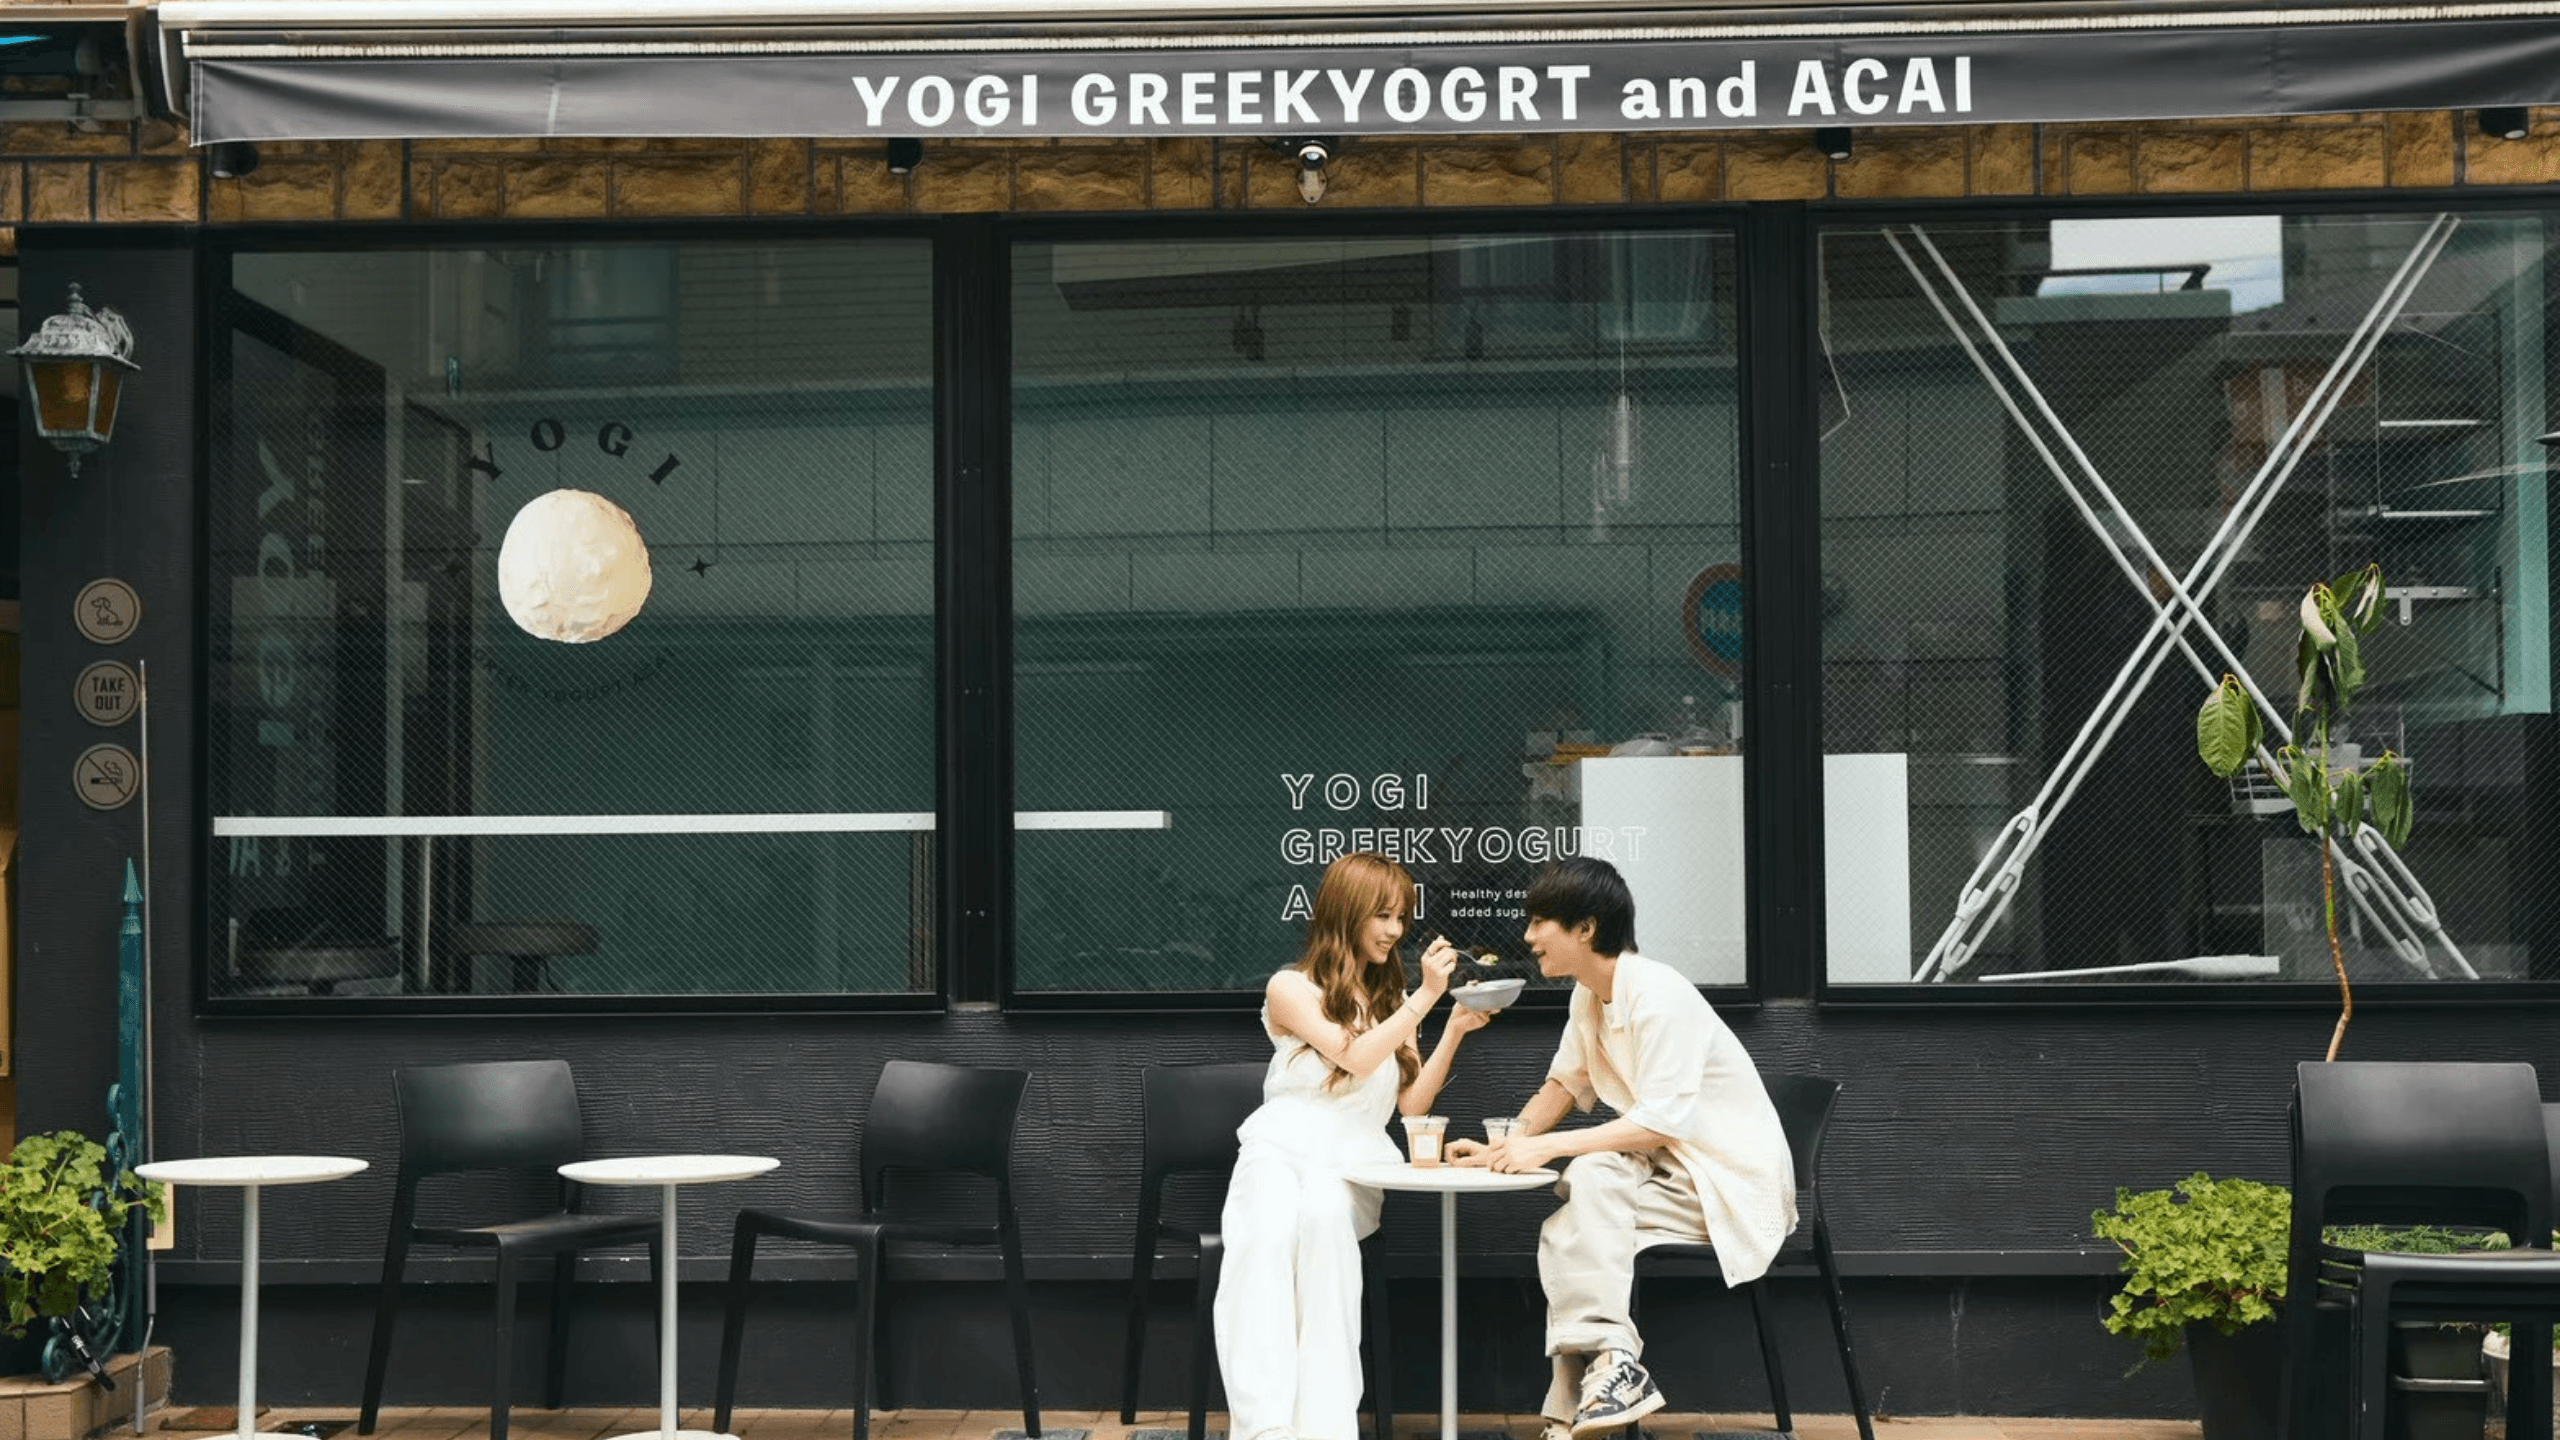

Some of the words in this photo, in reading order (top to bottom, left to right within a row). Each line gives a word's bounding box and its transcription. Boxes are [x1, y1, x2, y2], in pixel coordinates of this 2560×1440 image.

[851, 74, 1038, 127] YOGI
[1070, 65, 1591, 127] GREEKYOGRT
[1620, 60, 1757, 119] and
[1787, 56, 1973, 117] ACAI
[467, 418, 681, 486] YOGI
[92, 676, 125, 693] TAKE
[95, 695, 122, 711] OUT
[1281, 773, 1428, 810] YOGI
[1281, 826, 1647, 865] GREEKYOGURT
[1281, 883, 1425, 921] AI
[1450, 888, 1502, 902] Healthy
[1505, 888, 1528, 899] des
[1450, 906, 1492, 918] added
[1495, 906, 1527, 920] suga
